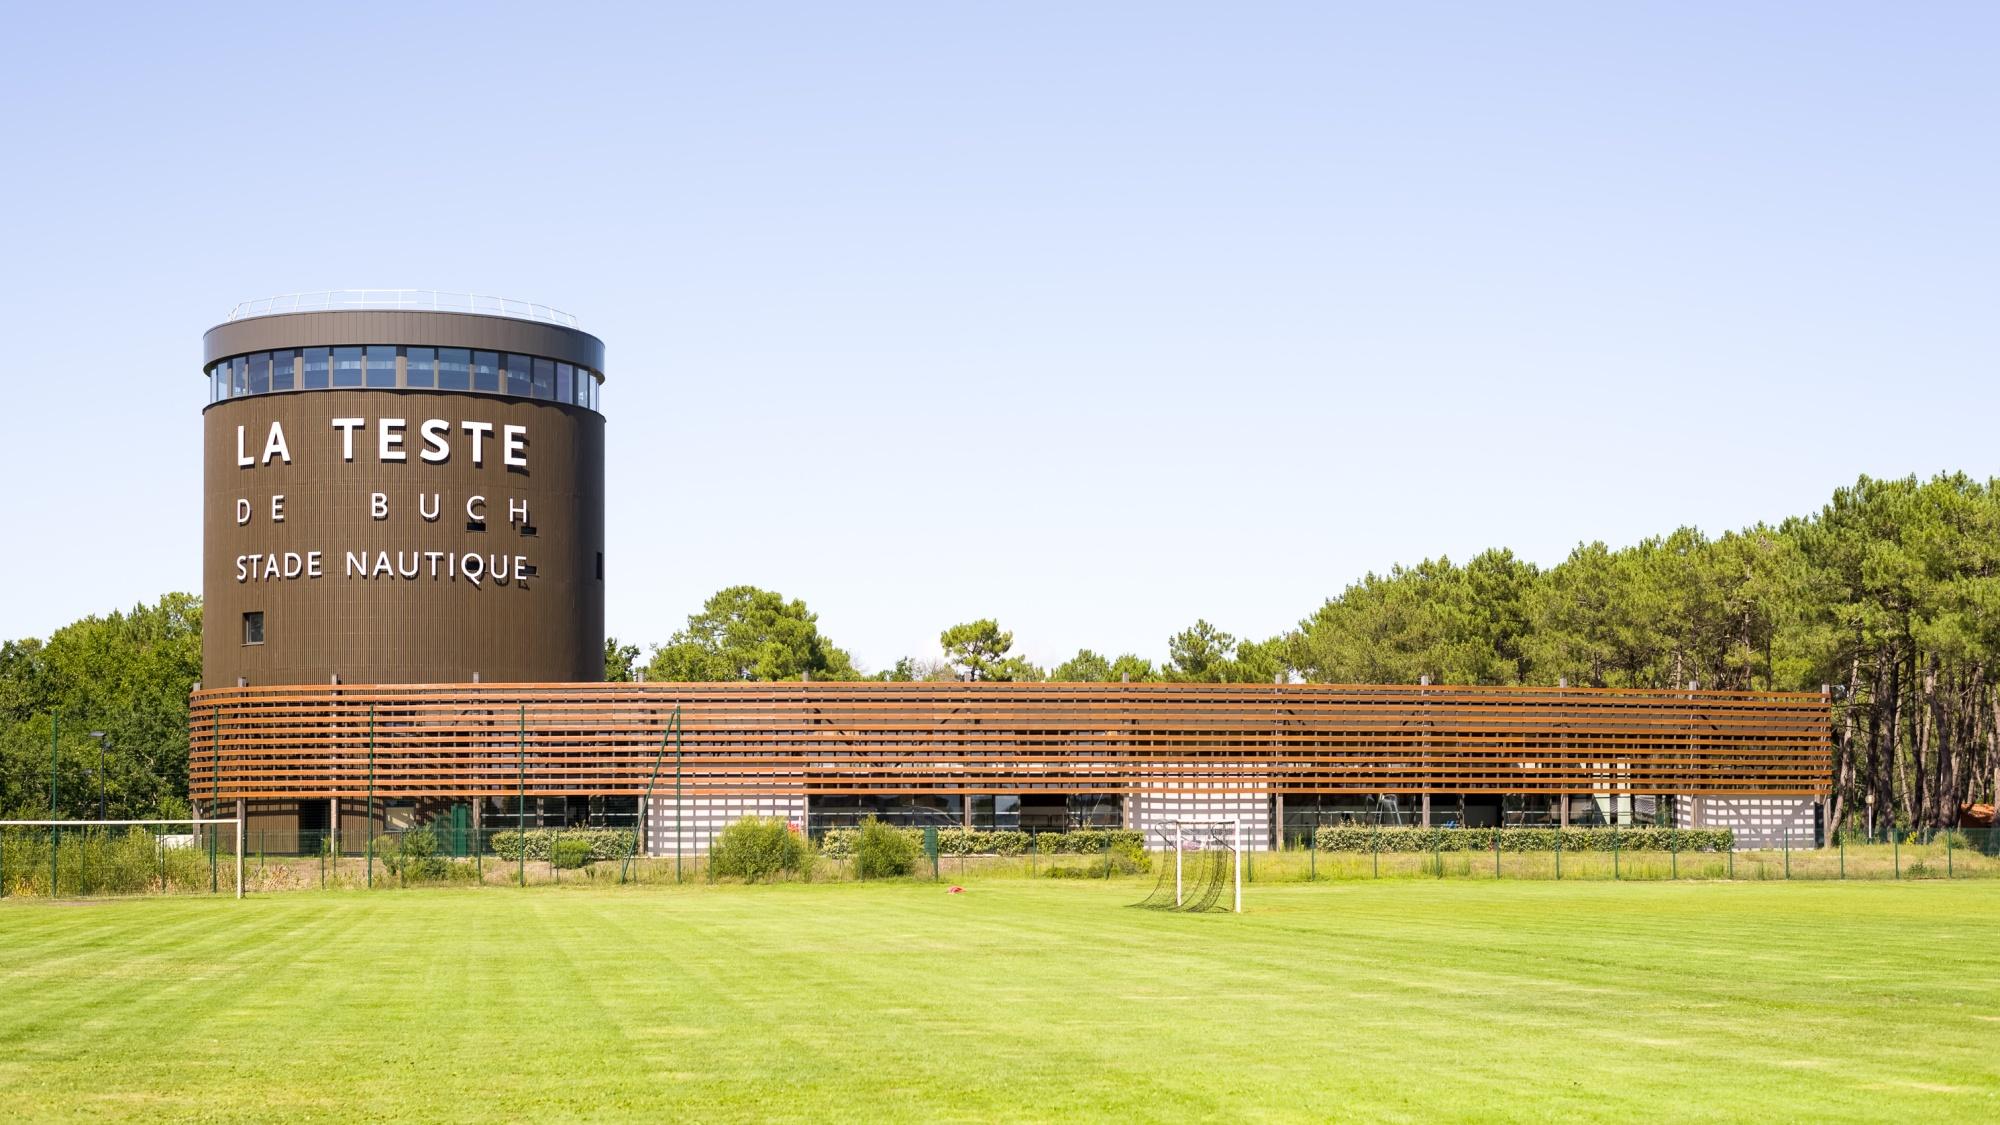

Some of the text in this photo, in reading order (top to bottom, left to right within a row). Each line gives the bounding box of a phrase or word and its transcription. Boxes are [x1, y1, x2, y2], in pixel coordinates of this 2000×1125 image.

[237, 417, 528, 467] LA TESTE
[236, 492, 528, 523] DE BUCH
[236, 550, 528, 585] STADE NAUTIQUE
